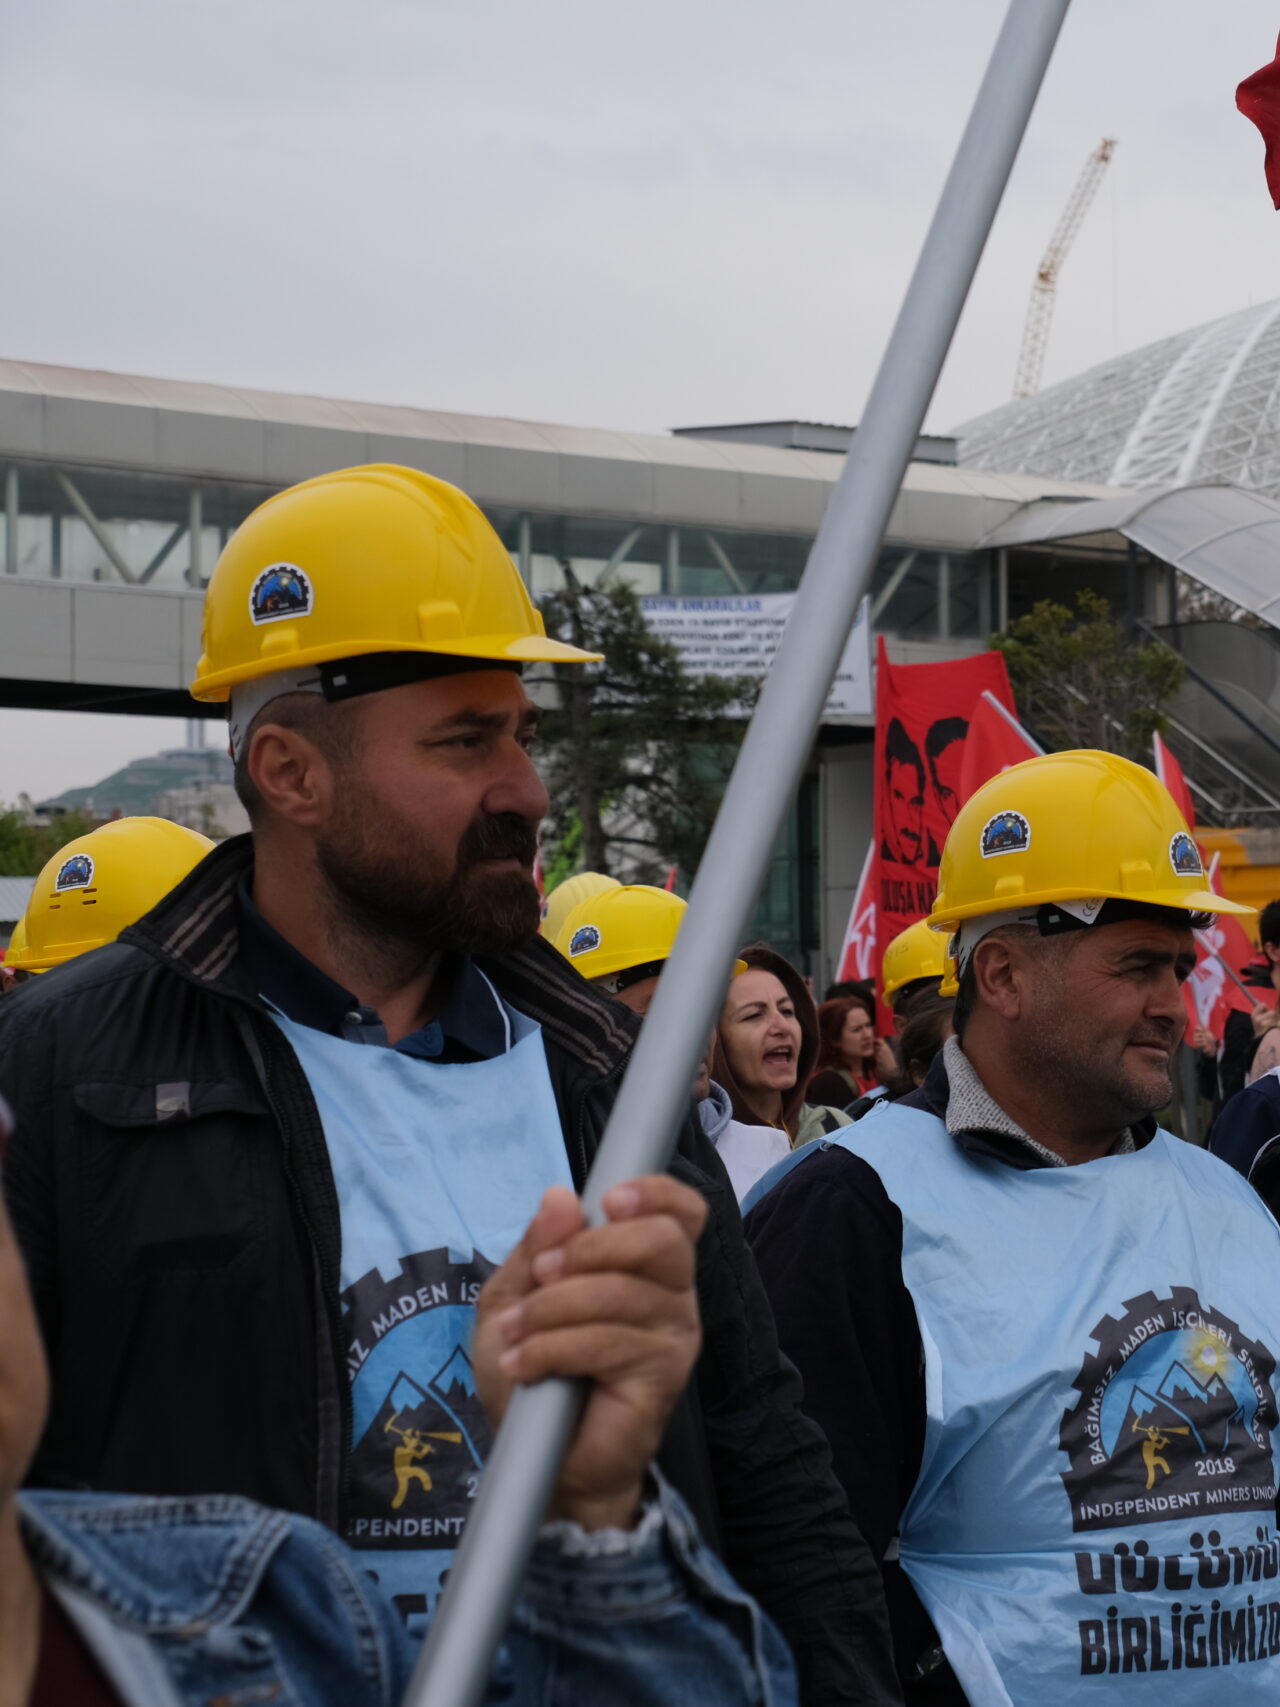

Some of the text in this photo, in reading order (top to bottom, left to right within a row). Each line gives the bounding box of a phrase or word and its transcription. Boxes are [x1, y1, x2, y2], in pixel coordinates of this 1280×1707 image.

[371, 1282, 449, 1338] MADEN
[1084, 1365, 1117, 1465] BAĞIMSIZ
[1119, 1313, 1166, 1361] MADEN
[1171, 1307, 1233, 1347] İŞÇİLERİ
[1194, 1457, 1236, 1476] 2018
[1206, 1486, 1250, 1504] MINERS
[348, 1517, 465, 1537] PENDENT
